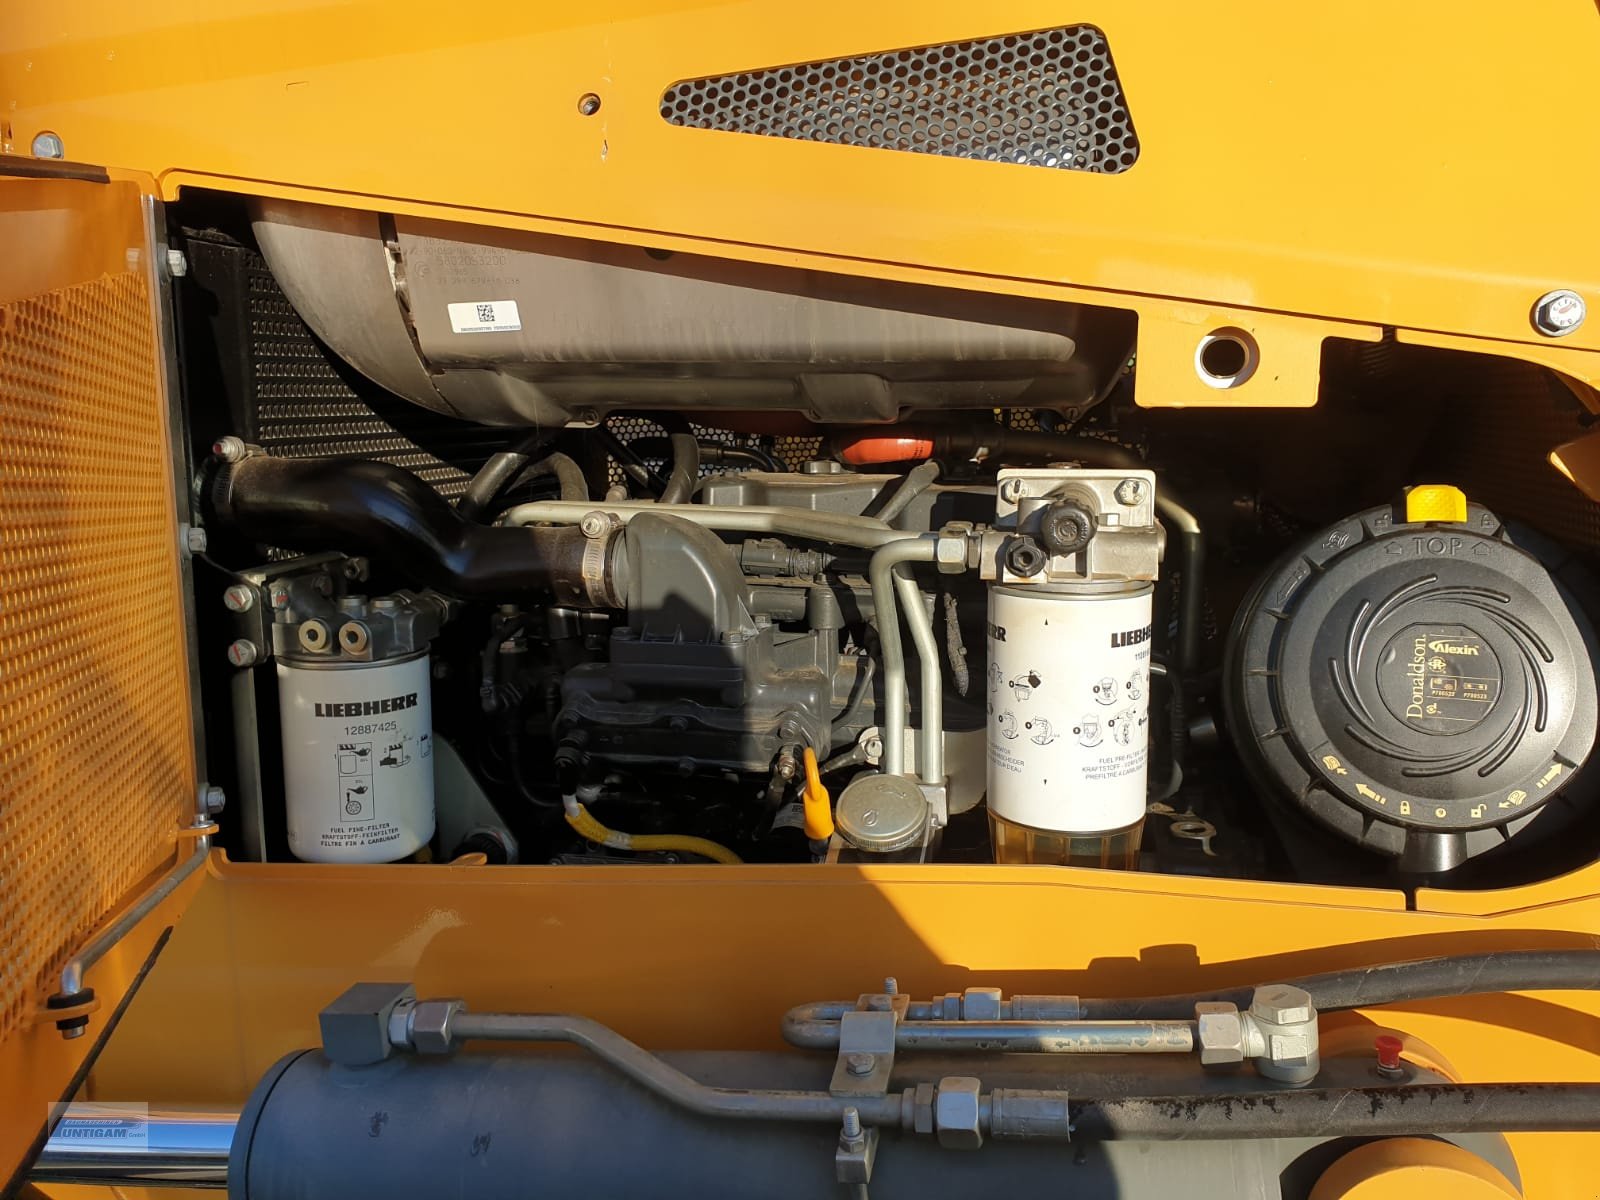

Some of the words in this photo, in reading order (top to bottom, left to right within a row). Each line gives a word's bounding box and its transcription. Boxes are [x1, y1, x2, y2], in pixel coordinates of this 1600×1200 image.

[1411, 536, 1463, 557] TOP
[1428, 639, 1479, 656] Alexin
[314, 692, 418, 718] LIEBHERR
[344, 720, 397, 736] 12887425
